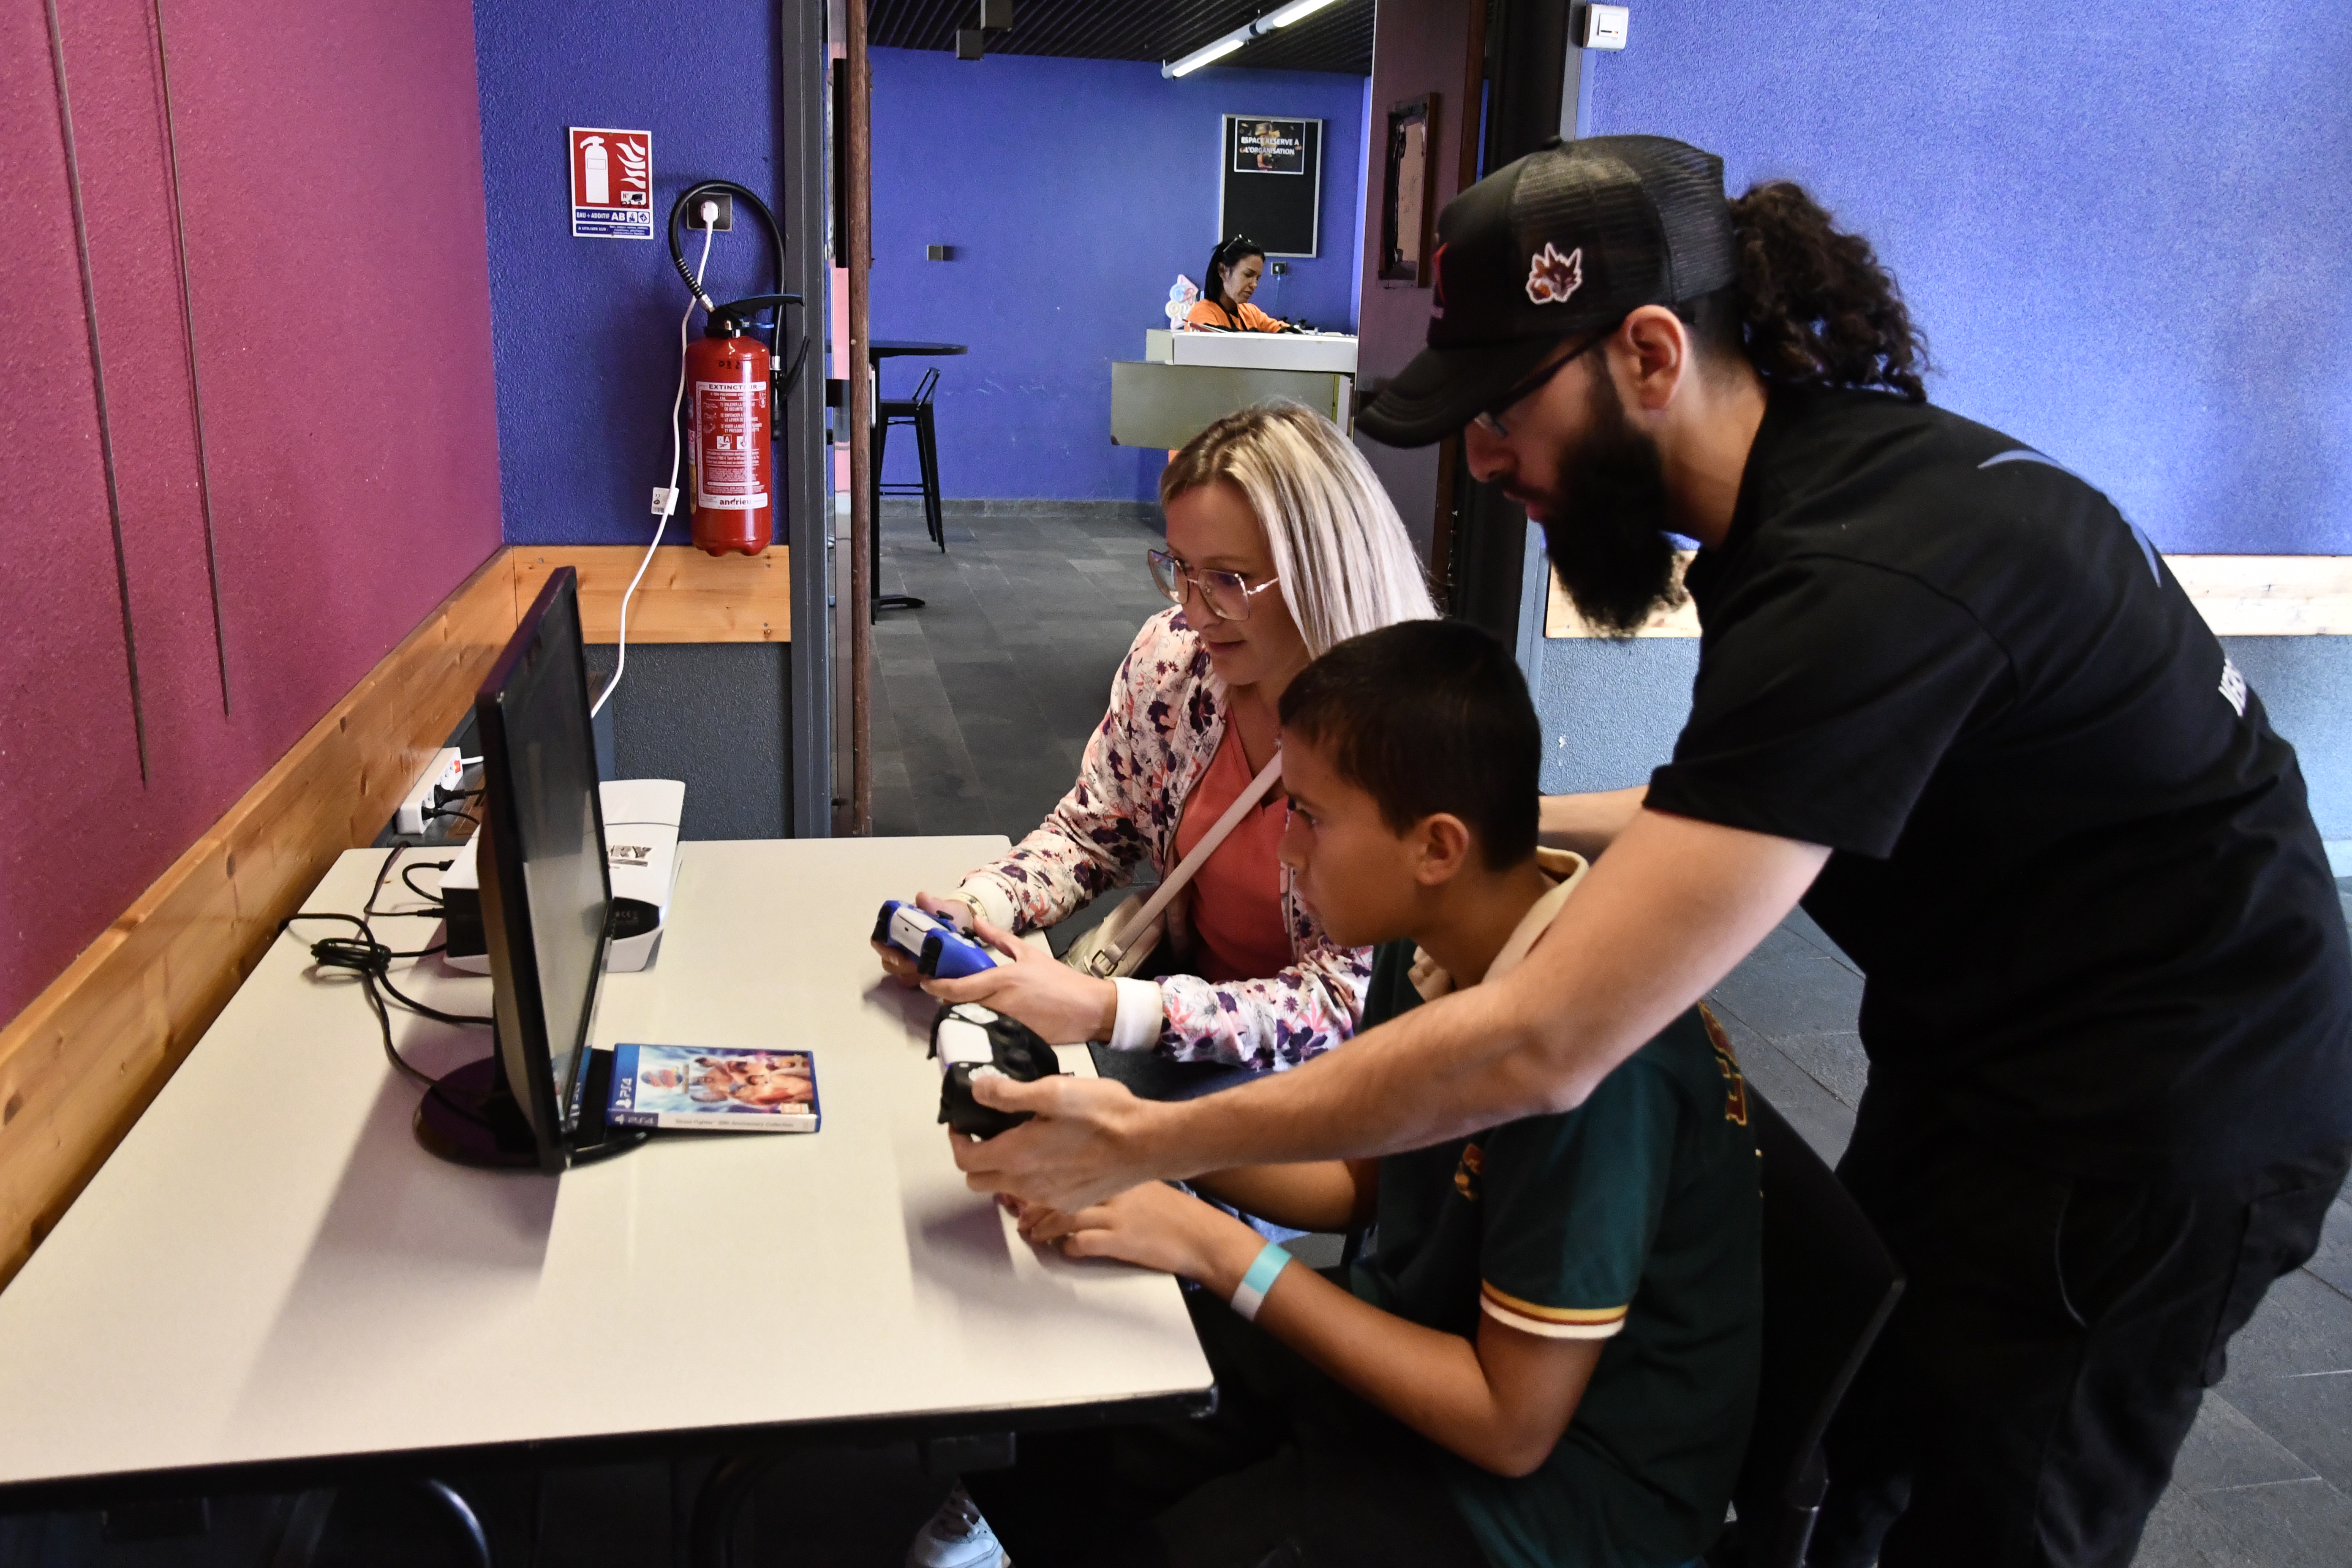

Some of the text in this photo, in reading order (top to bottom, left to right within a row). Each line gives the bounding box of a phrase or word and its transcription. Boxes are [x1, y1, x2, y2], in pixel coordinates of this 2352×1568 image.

[1241, 136, 1263, 144] ESPACE
[1245, 146, 1295, 155] L'ORGANISATION
[611, 212, 626, 221] AB
[719, 497, 751, 505] andrieu
[607, 845, 652, 859] RY
